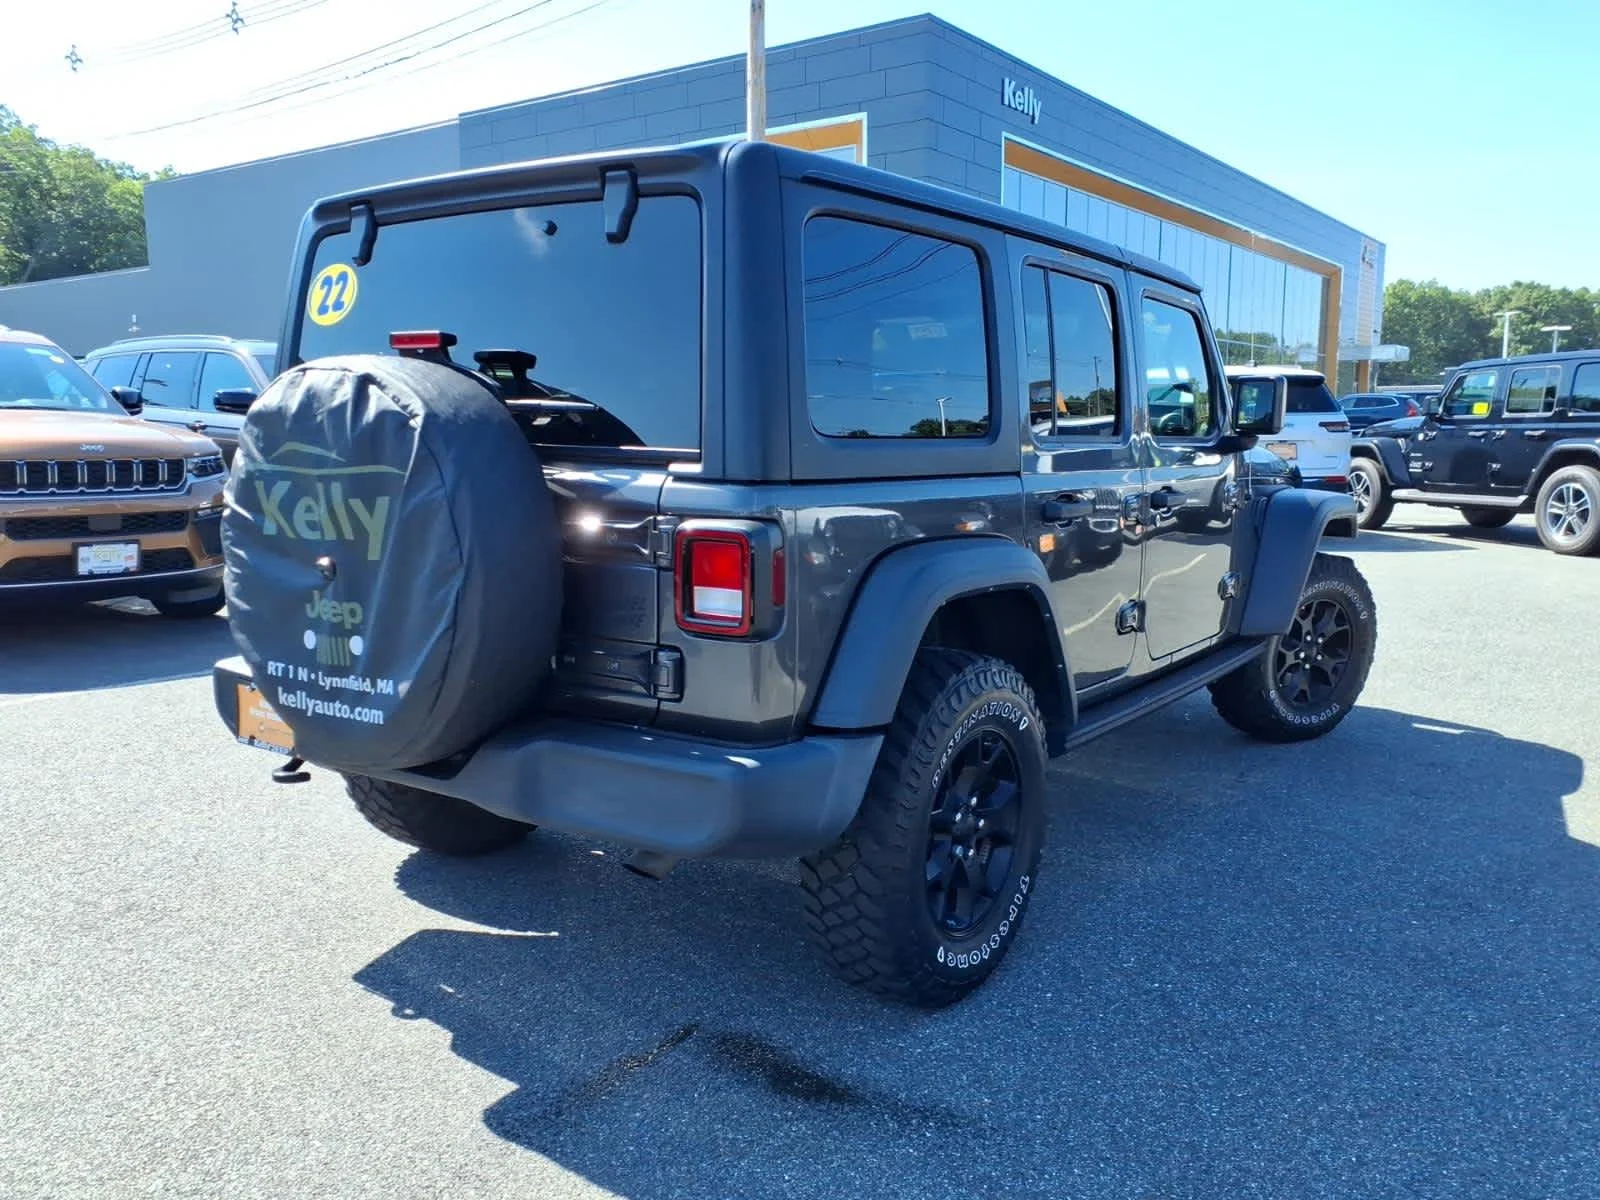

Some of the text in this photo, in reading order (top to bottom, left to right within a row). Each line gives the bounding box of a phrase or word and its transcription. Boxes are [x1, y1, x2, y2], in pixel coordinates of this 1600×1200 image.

[1002, 78, 1041, 124] Kelly
[317, 271, 348, 316] 22
[254, 480, 390, 560] Kelly
[306, 590, 363, 629] Jeep
[267, 661, 285, 677] RT
[288, 665, 294, 679] 1
[298, 667, 308, 682] N
[376, 678, 394, 695] MA
[278, 686, 384, 725] kellyauto.com
